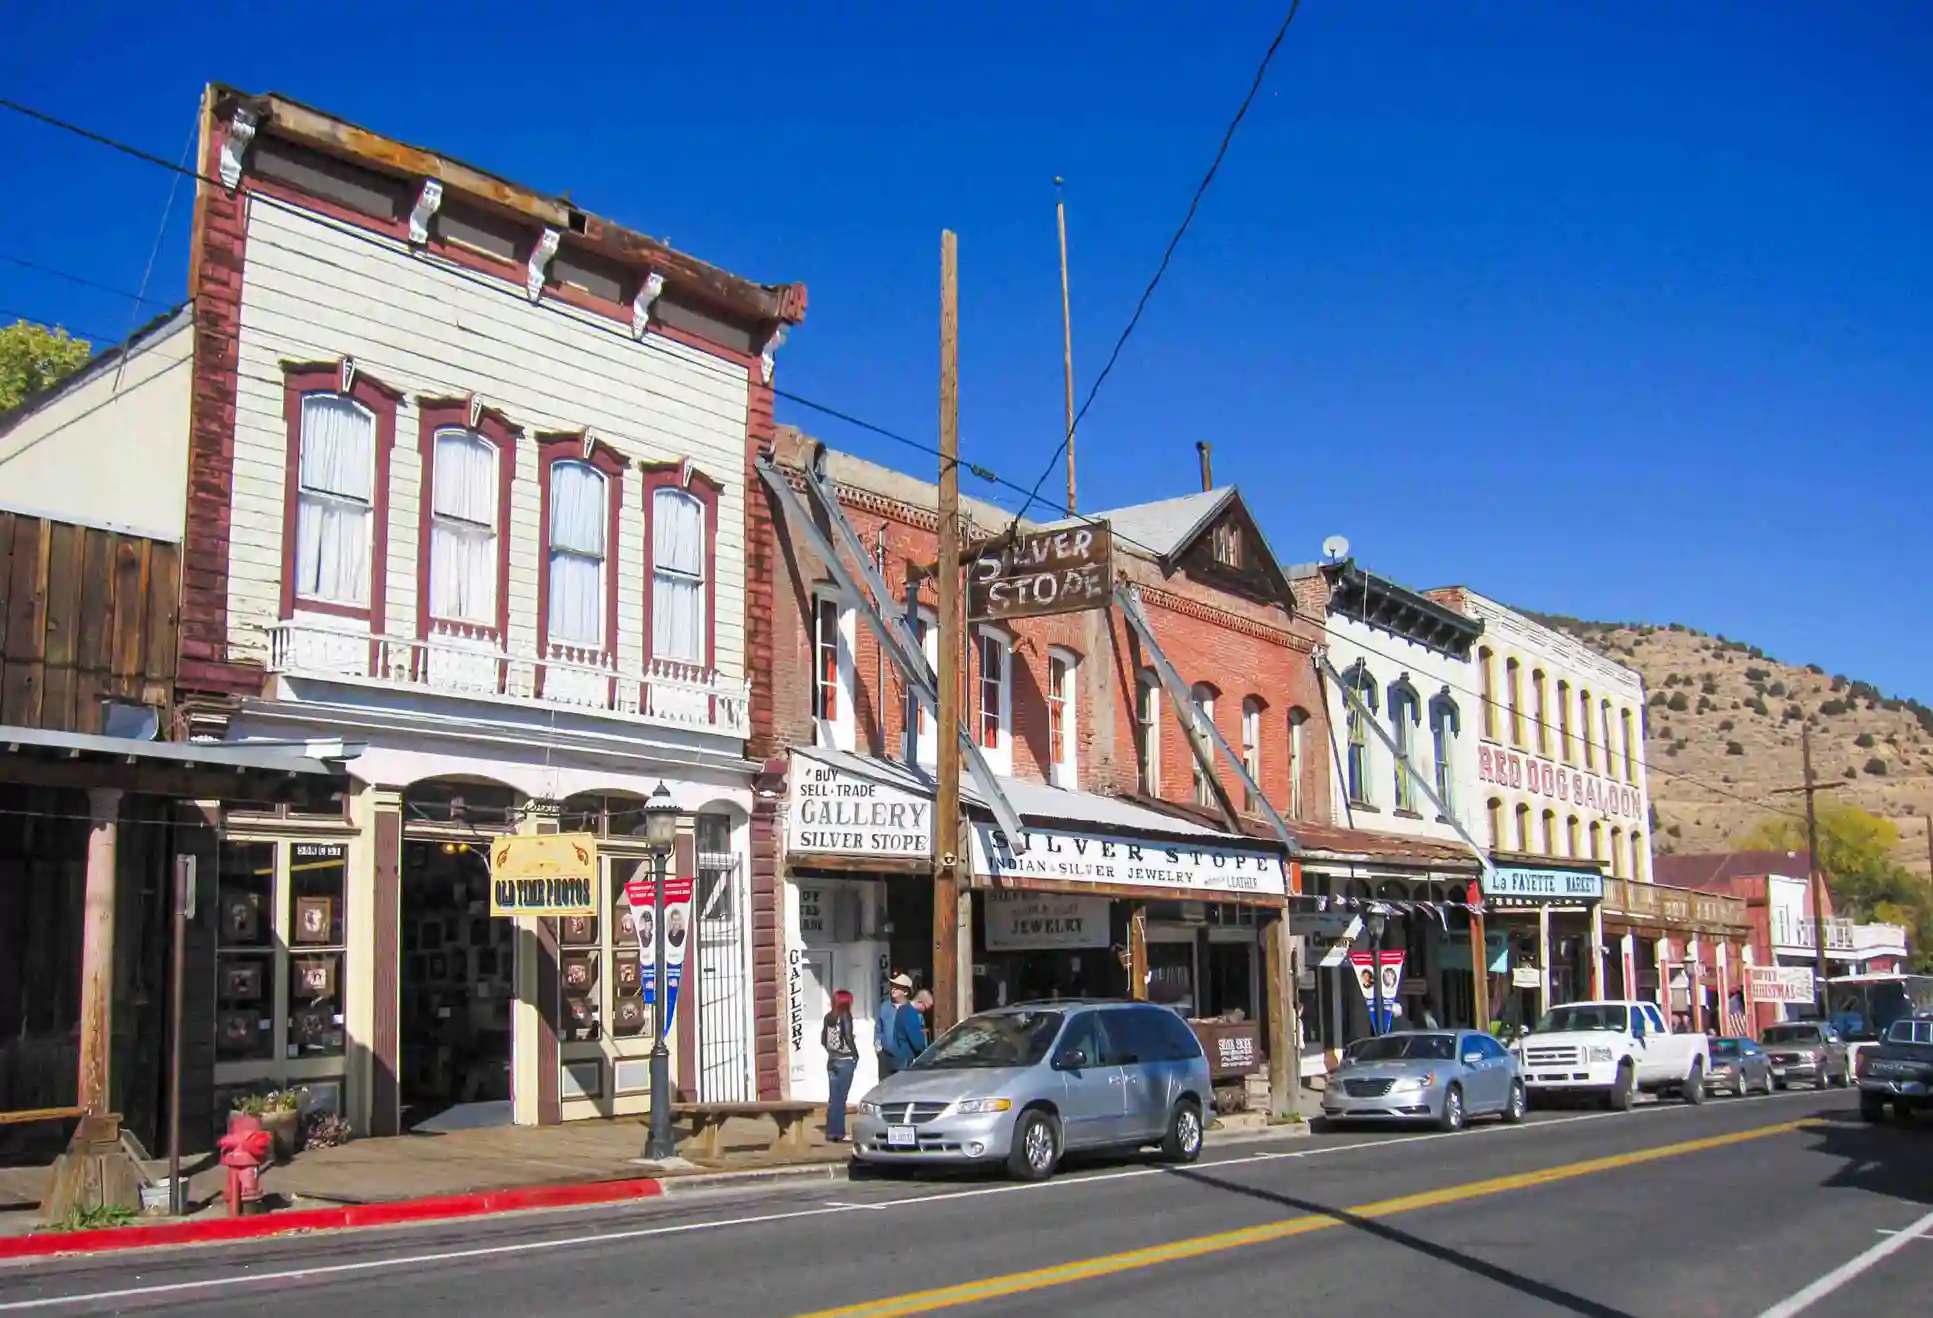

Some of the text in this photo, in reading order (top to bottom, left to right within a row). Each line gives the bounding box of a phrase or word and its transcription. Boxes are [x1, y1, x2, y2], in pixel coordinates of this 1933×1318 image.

[977, 529, 1093, 581] SLVER
[987, 562, 1103, 613] STOPE
[815, 768, 839, 782] BUY
[1478, 746, 1643, 821] RED DOG SALOON
[800, 784, 876, 798] SELL TRADE
[801, 799, 927, 829] GALLERY
[800, 831, 928, 851] SILVER STOPE
[991, 830, 1269, 872] SILVER STOPE
[988, 856, 1046, 873] INDIAN
[1058, 862, 1116, 878] SILVER
[1127, 866, 1194, 883] JEWELRY
[1511, 873, 1556, 893] FAYETTE
[1565, 875, 1596, 893] MARKET
[495, 877, 591, 908] OLD TIME PHOTOS
[1010, 917, 1084, 935] JEWELRY
[789, 948, 804, 1052] GALLERY
